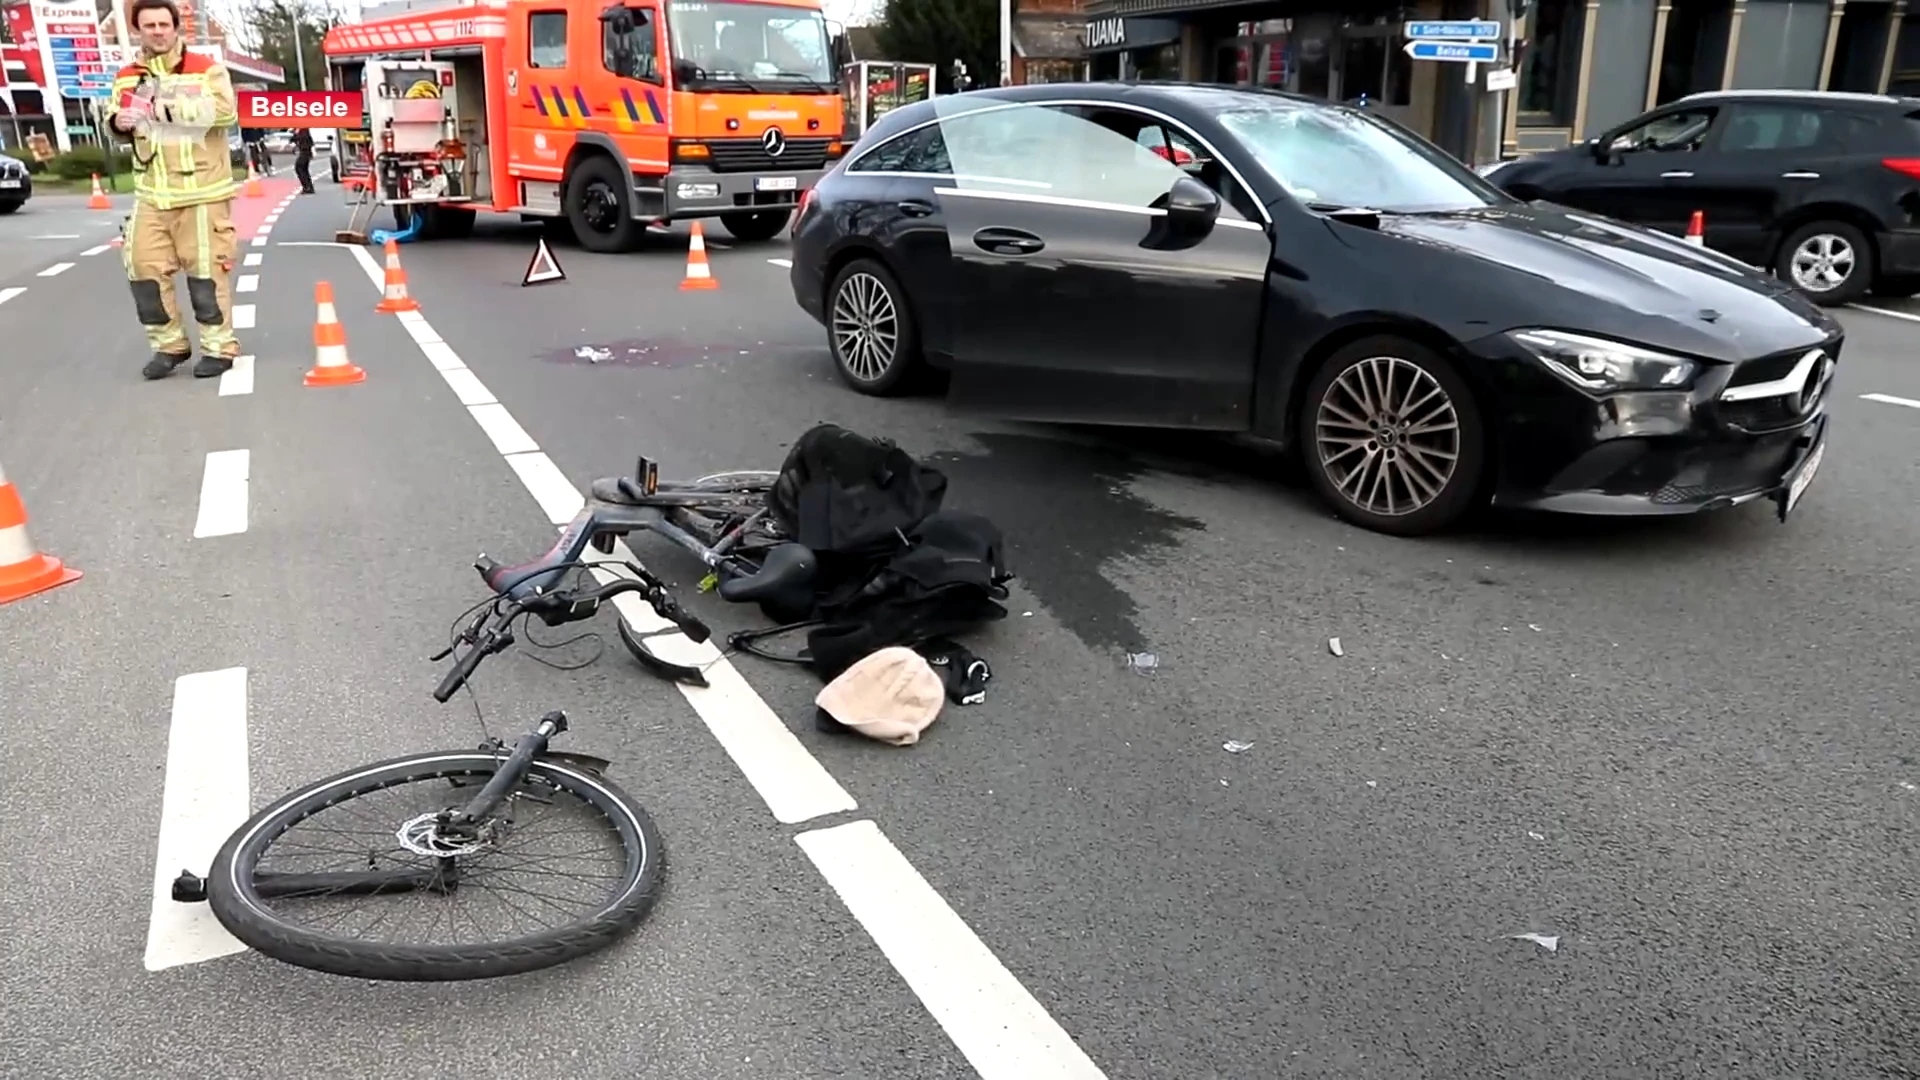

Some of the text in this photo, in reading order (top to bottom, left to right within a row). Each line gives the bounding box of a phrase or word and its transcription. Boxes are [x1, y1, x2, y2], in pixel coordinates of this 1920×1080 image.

[42, 6, 91, 18] Express
[460, 20, 473, 35] 112
[1086, 17, 1125, 47] TUANA
[1436, 45, 1470, 57] Belsele
